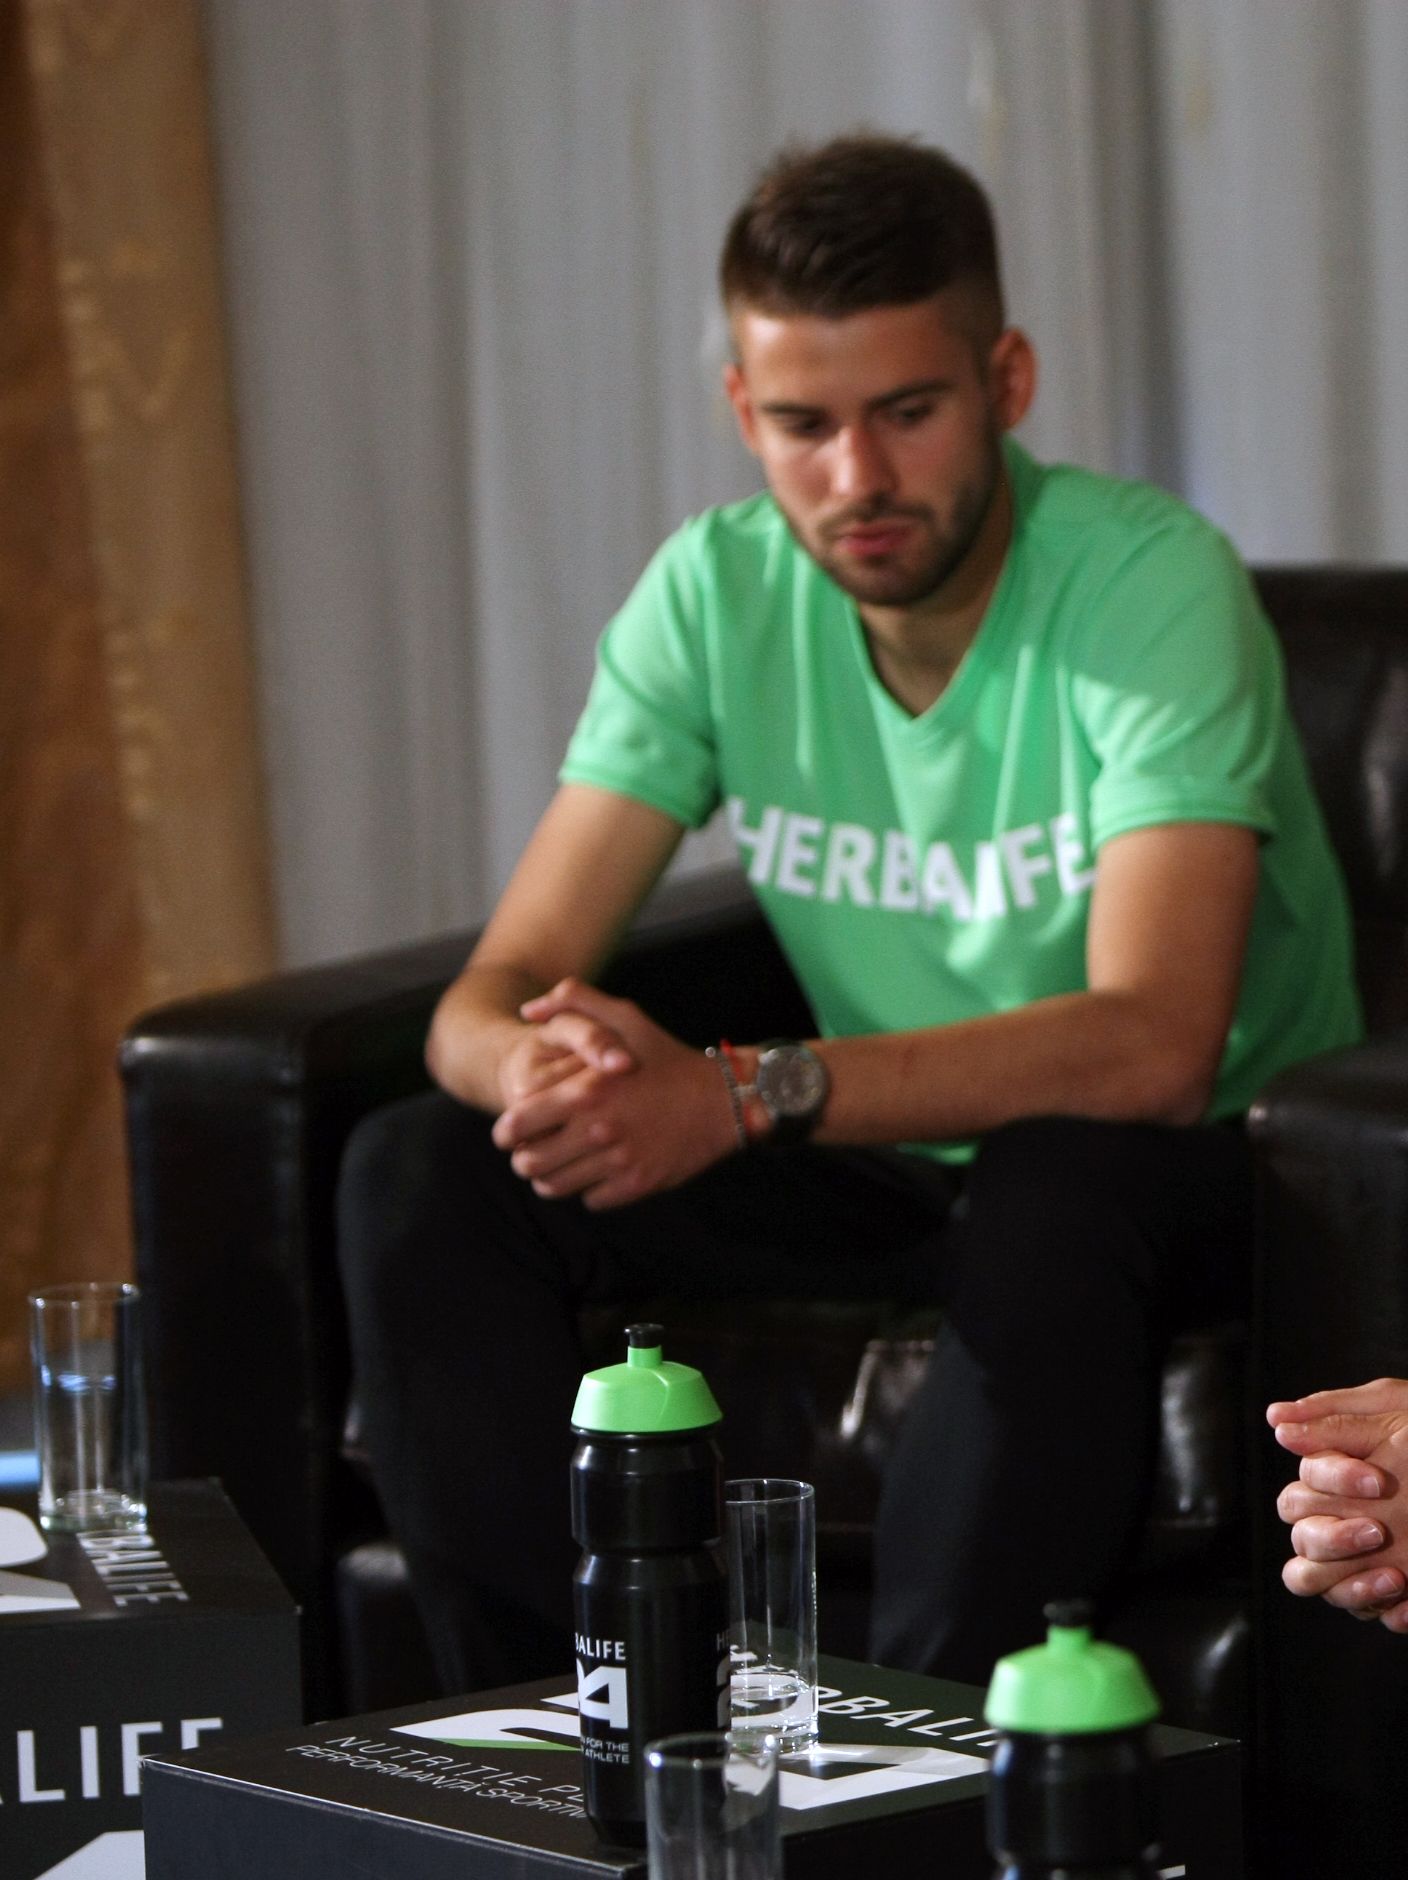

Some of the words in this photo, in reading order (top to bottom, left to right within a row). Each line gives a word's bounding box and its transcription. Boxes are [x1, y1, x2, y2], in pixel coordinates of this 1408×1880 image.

[724, 796, 1097, 922] HERBAIFE
[605, 1741, 629, 1752] THE
[584, 1748, 629, 1764] ATHLETE
